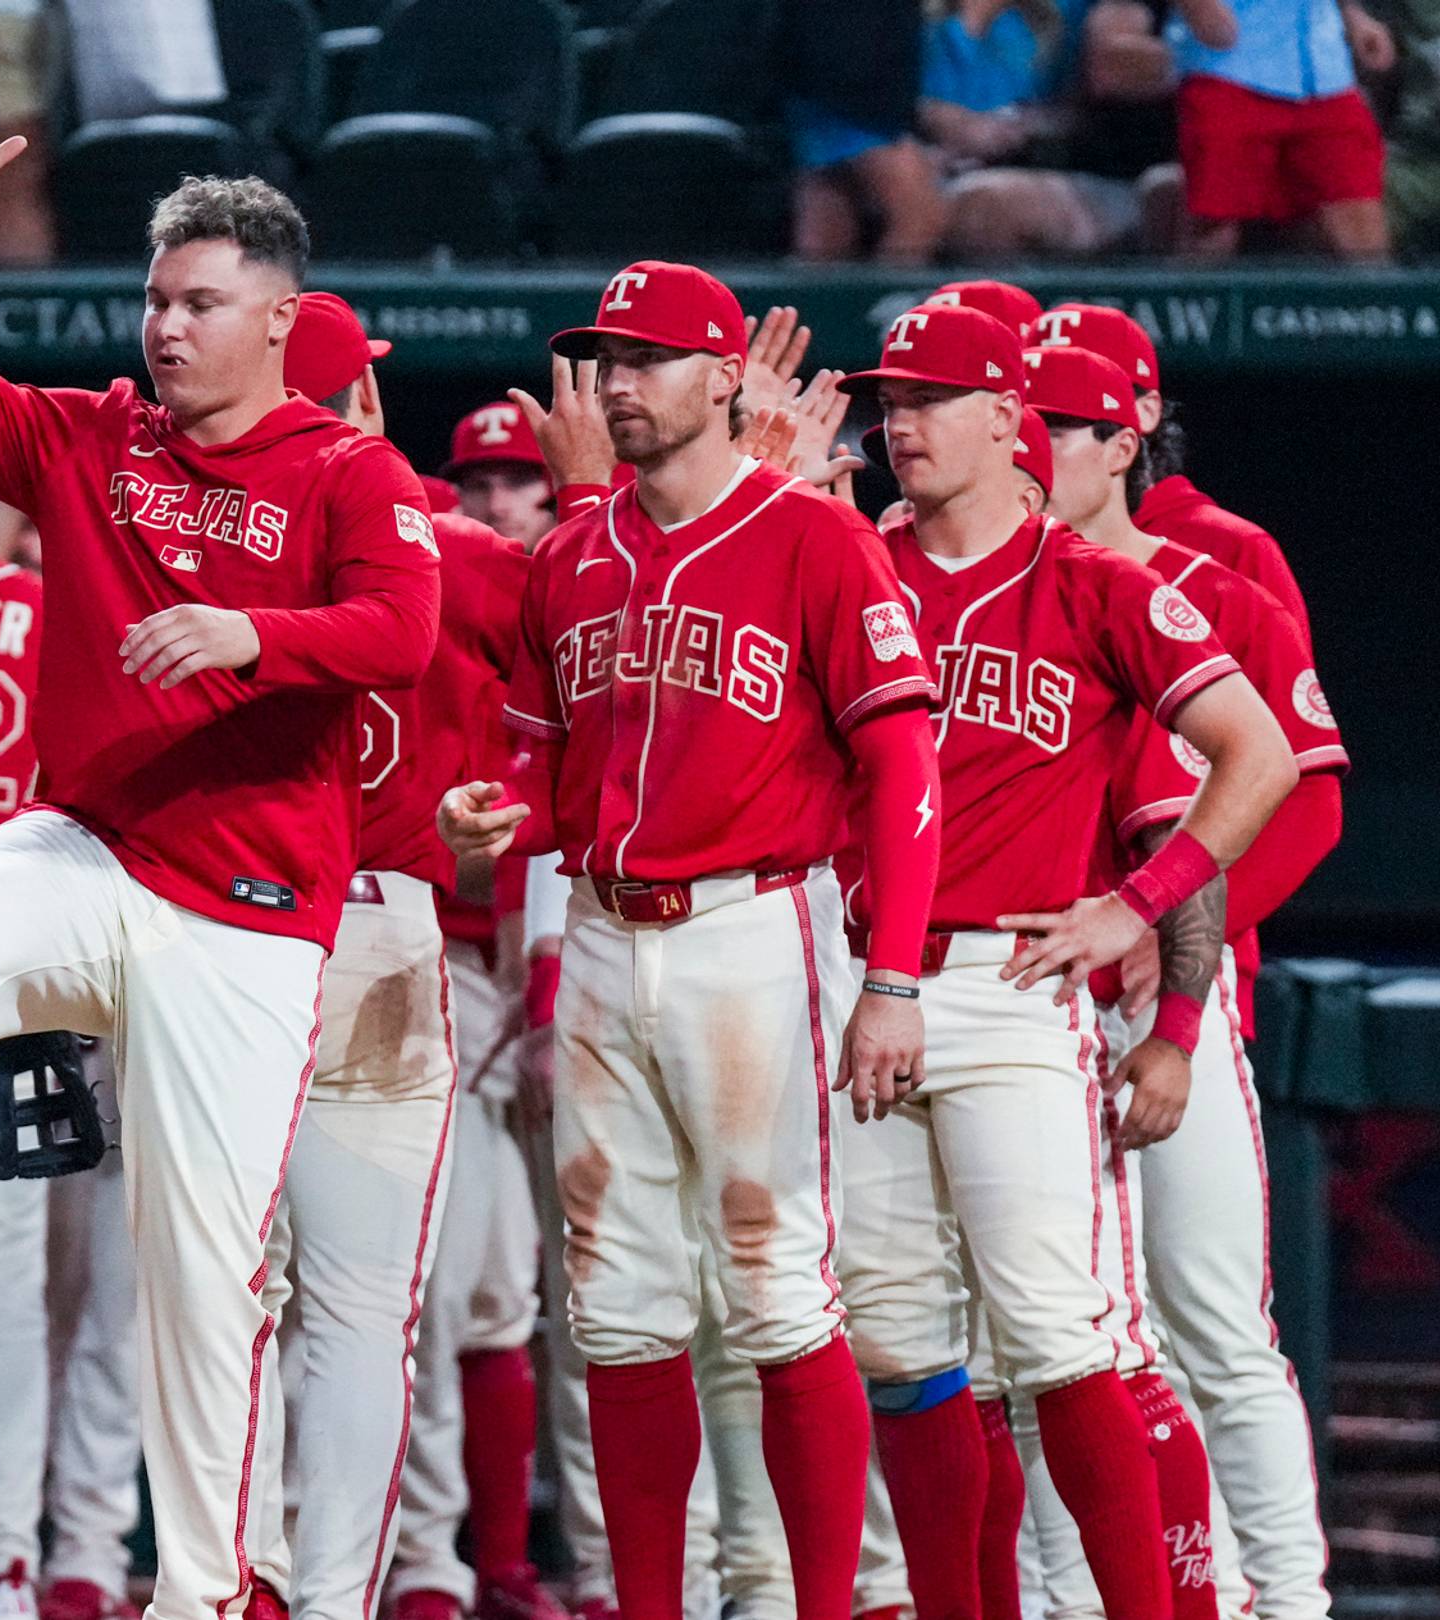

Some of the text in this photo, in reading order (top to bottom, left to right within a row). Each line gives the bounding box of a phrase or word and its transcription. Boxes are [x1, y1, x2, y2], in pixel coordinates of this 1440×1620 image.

[605, 272, 648, 312] T
[888, 312, 929, 351] T
[1037, 310, 1081, 348] T
[472, 406, 518, 446] T
[109, 470, 289, 562] TEJAS
[553, 603, 789, 724] TEJAS
[934, 642, 1076, 755] JAS
[658, 892, 680, 917] 24
